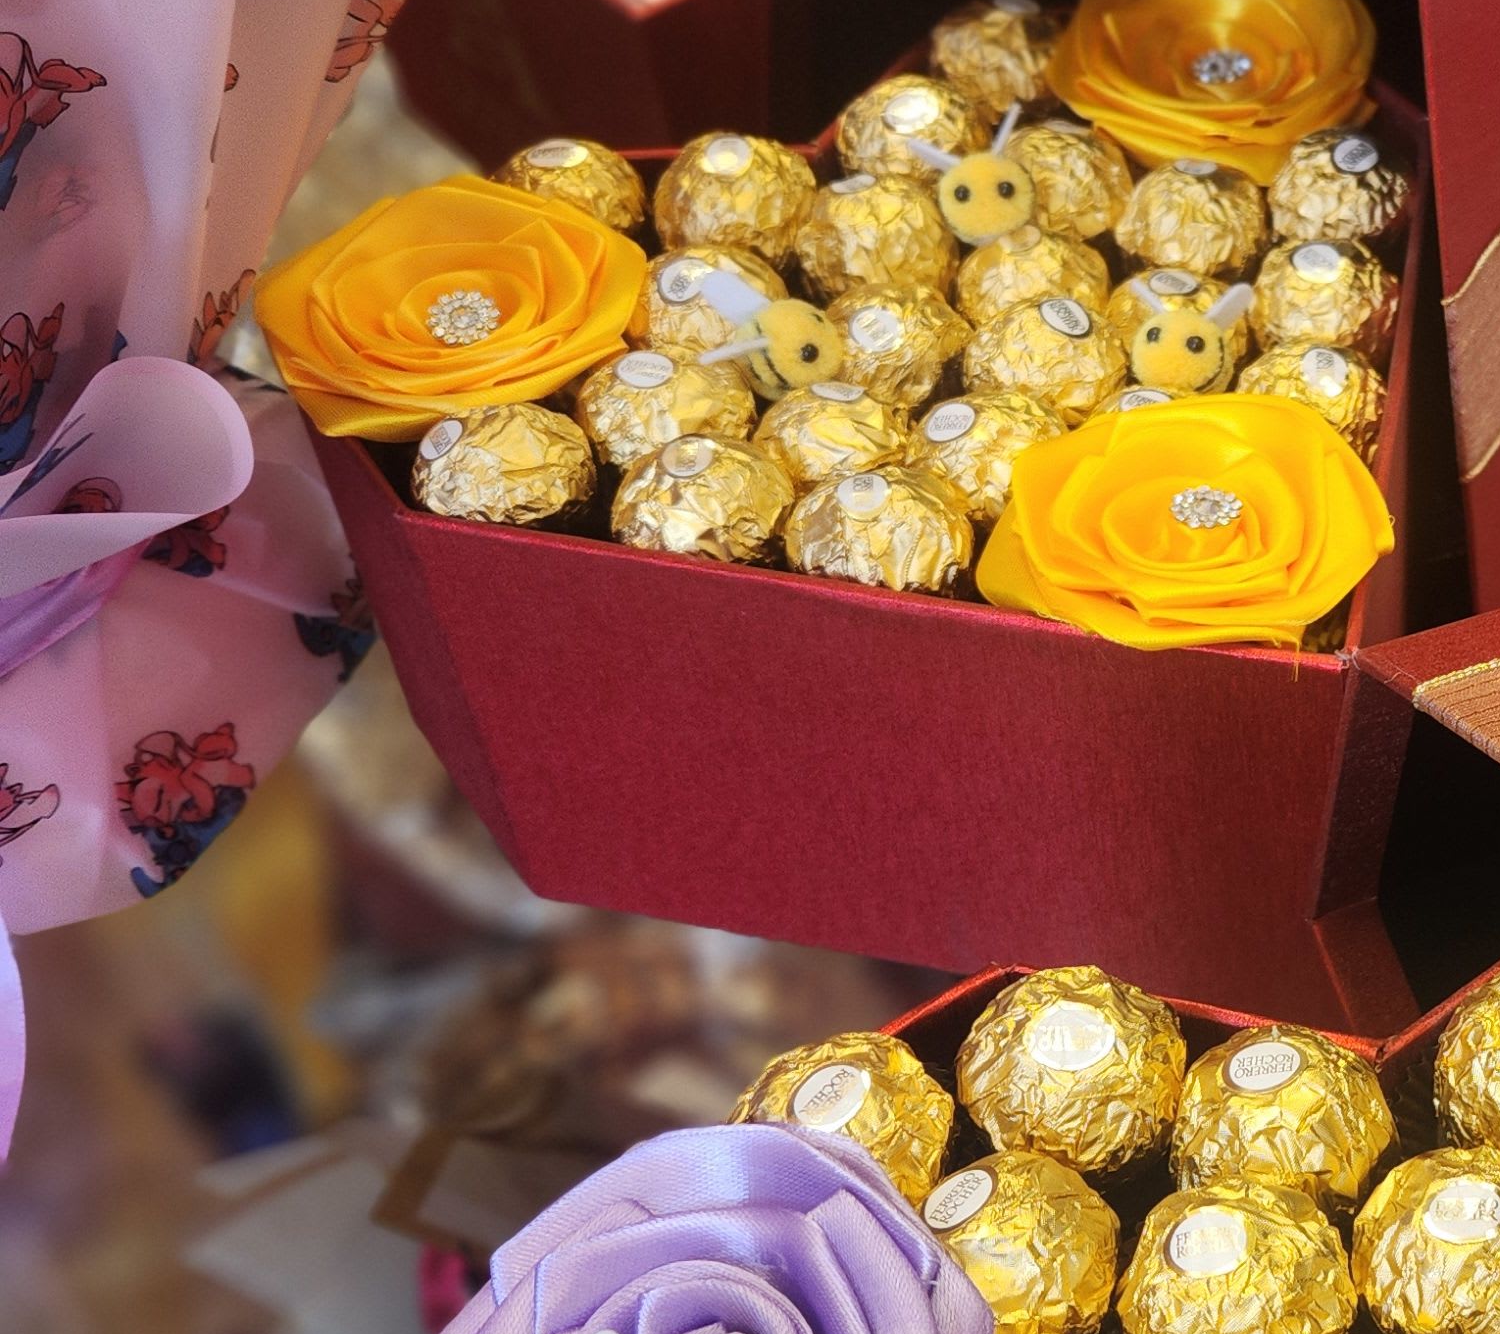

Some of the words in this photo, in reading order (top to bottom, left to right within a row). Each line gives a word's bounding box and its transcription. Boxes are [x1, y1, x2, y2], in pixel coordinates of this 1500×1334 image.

[1234, 1062, 1293, 1079] FERRERO
[1236, 1054, 1295, 1066] ROCHER
[798, 1068, 852, 1113] ROCHER
[929, 1172, 977, 1221] FERRERO
[939, 1175, 988, 1225] ROCHER
